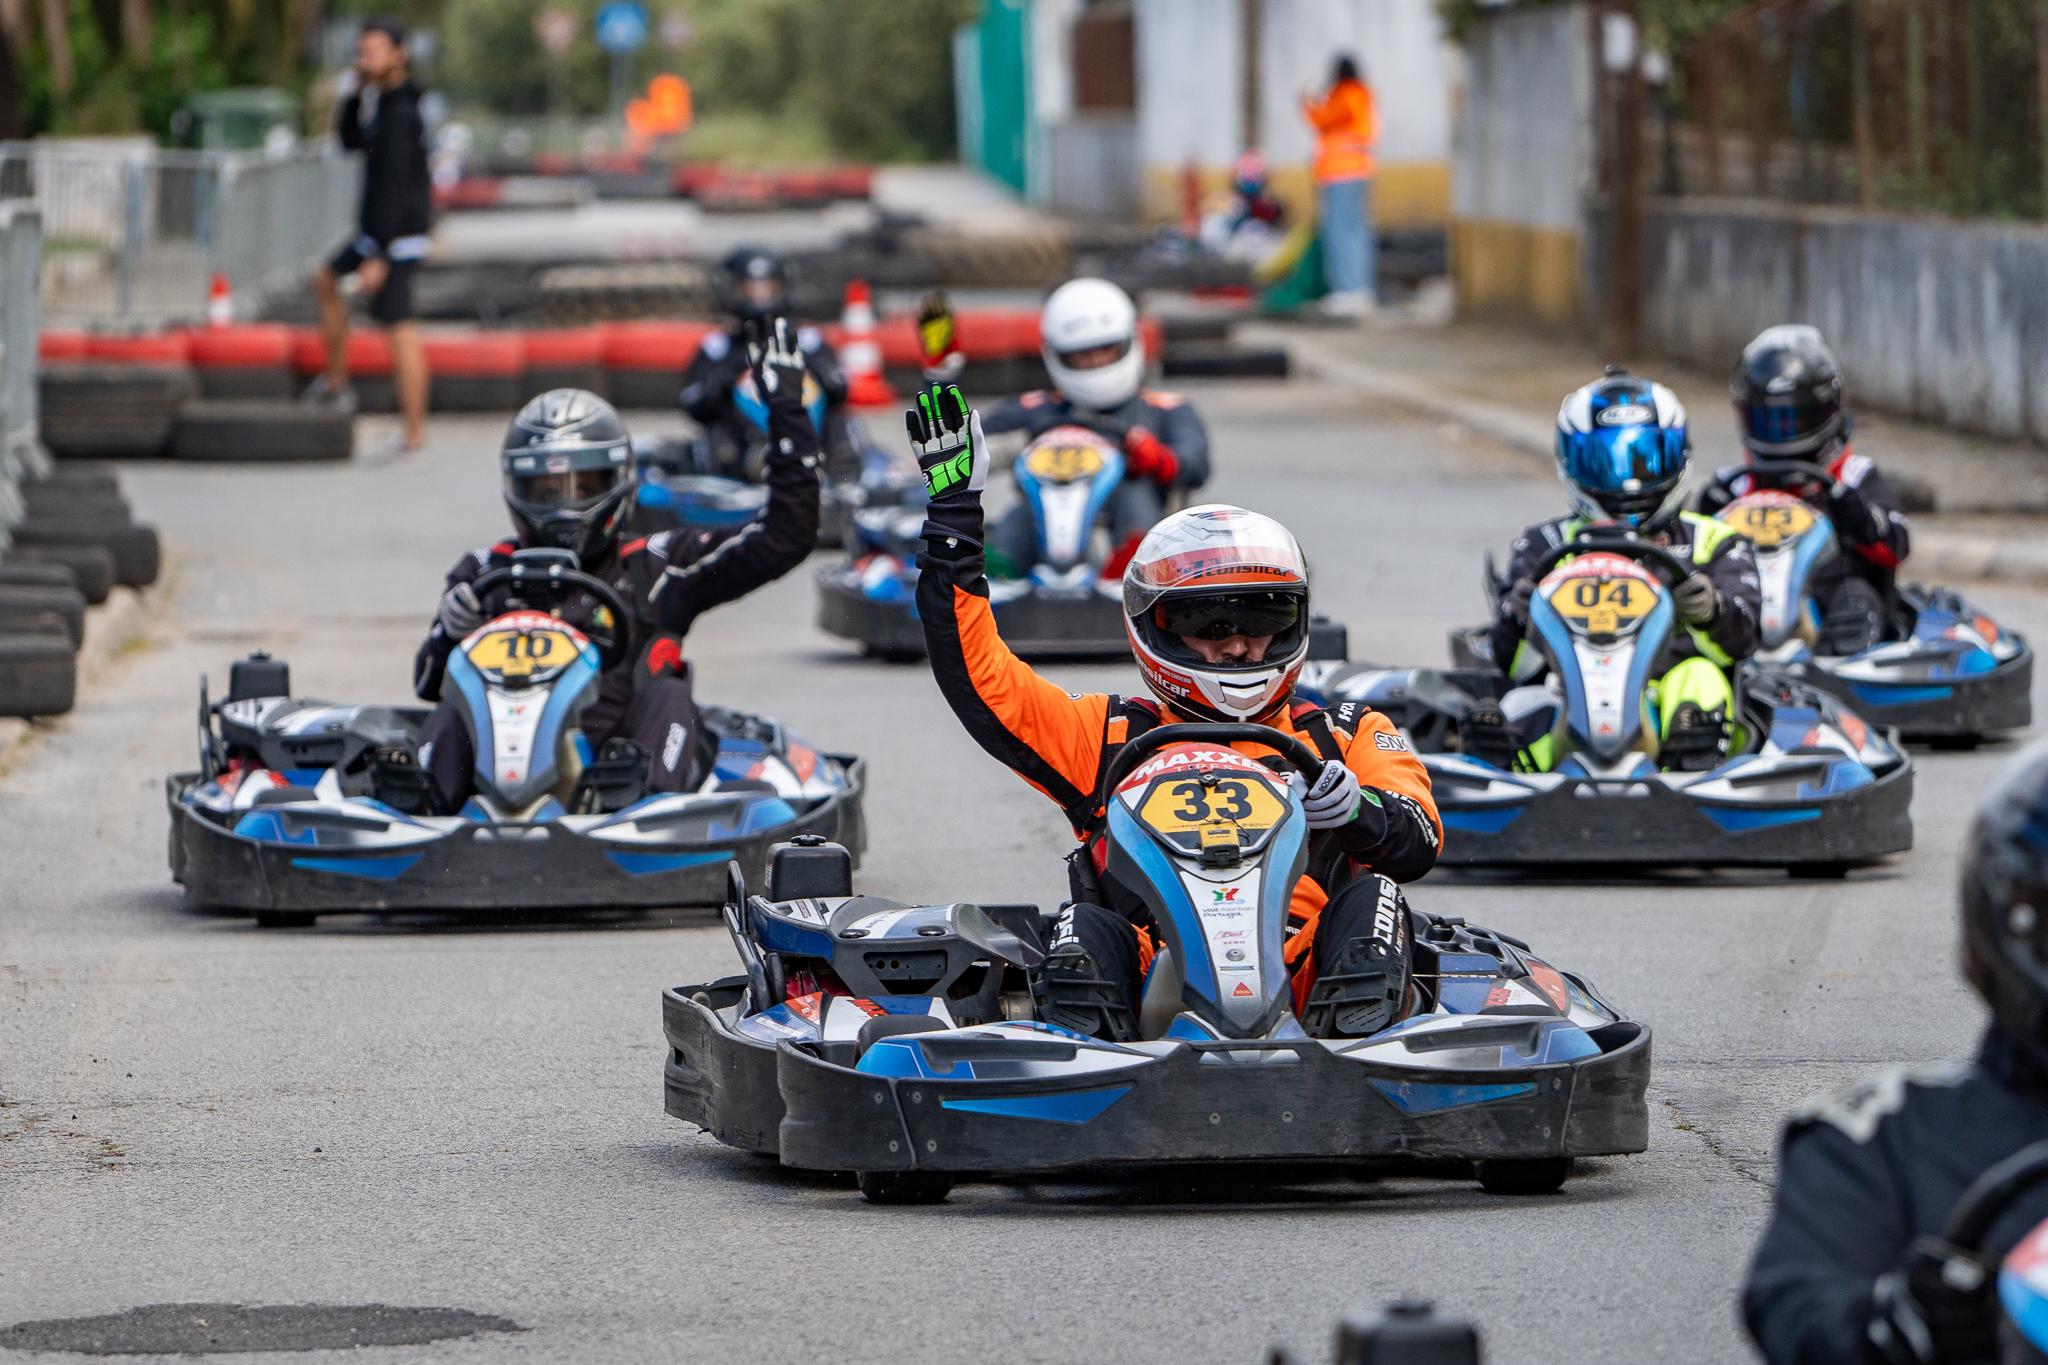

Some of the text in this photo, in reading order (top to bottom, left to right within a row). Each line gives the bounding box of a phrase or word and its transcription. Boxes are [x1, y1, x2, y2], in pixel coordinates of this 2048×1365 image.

[1575, 583, 1632, 608] 04
[498, 635, 553, 658] 10
[1134, 751, 1271, 781] MAXXIS
[1171, 781, 1253, 822] 33
